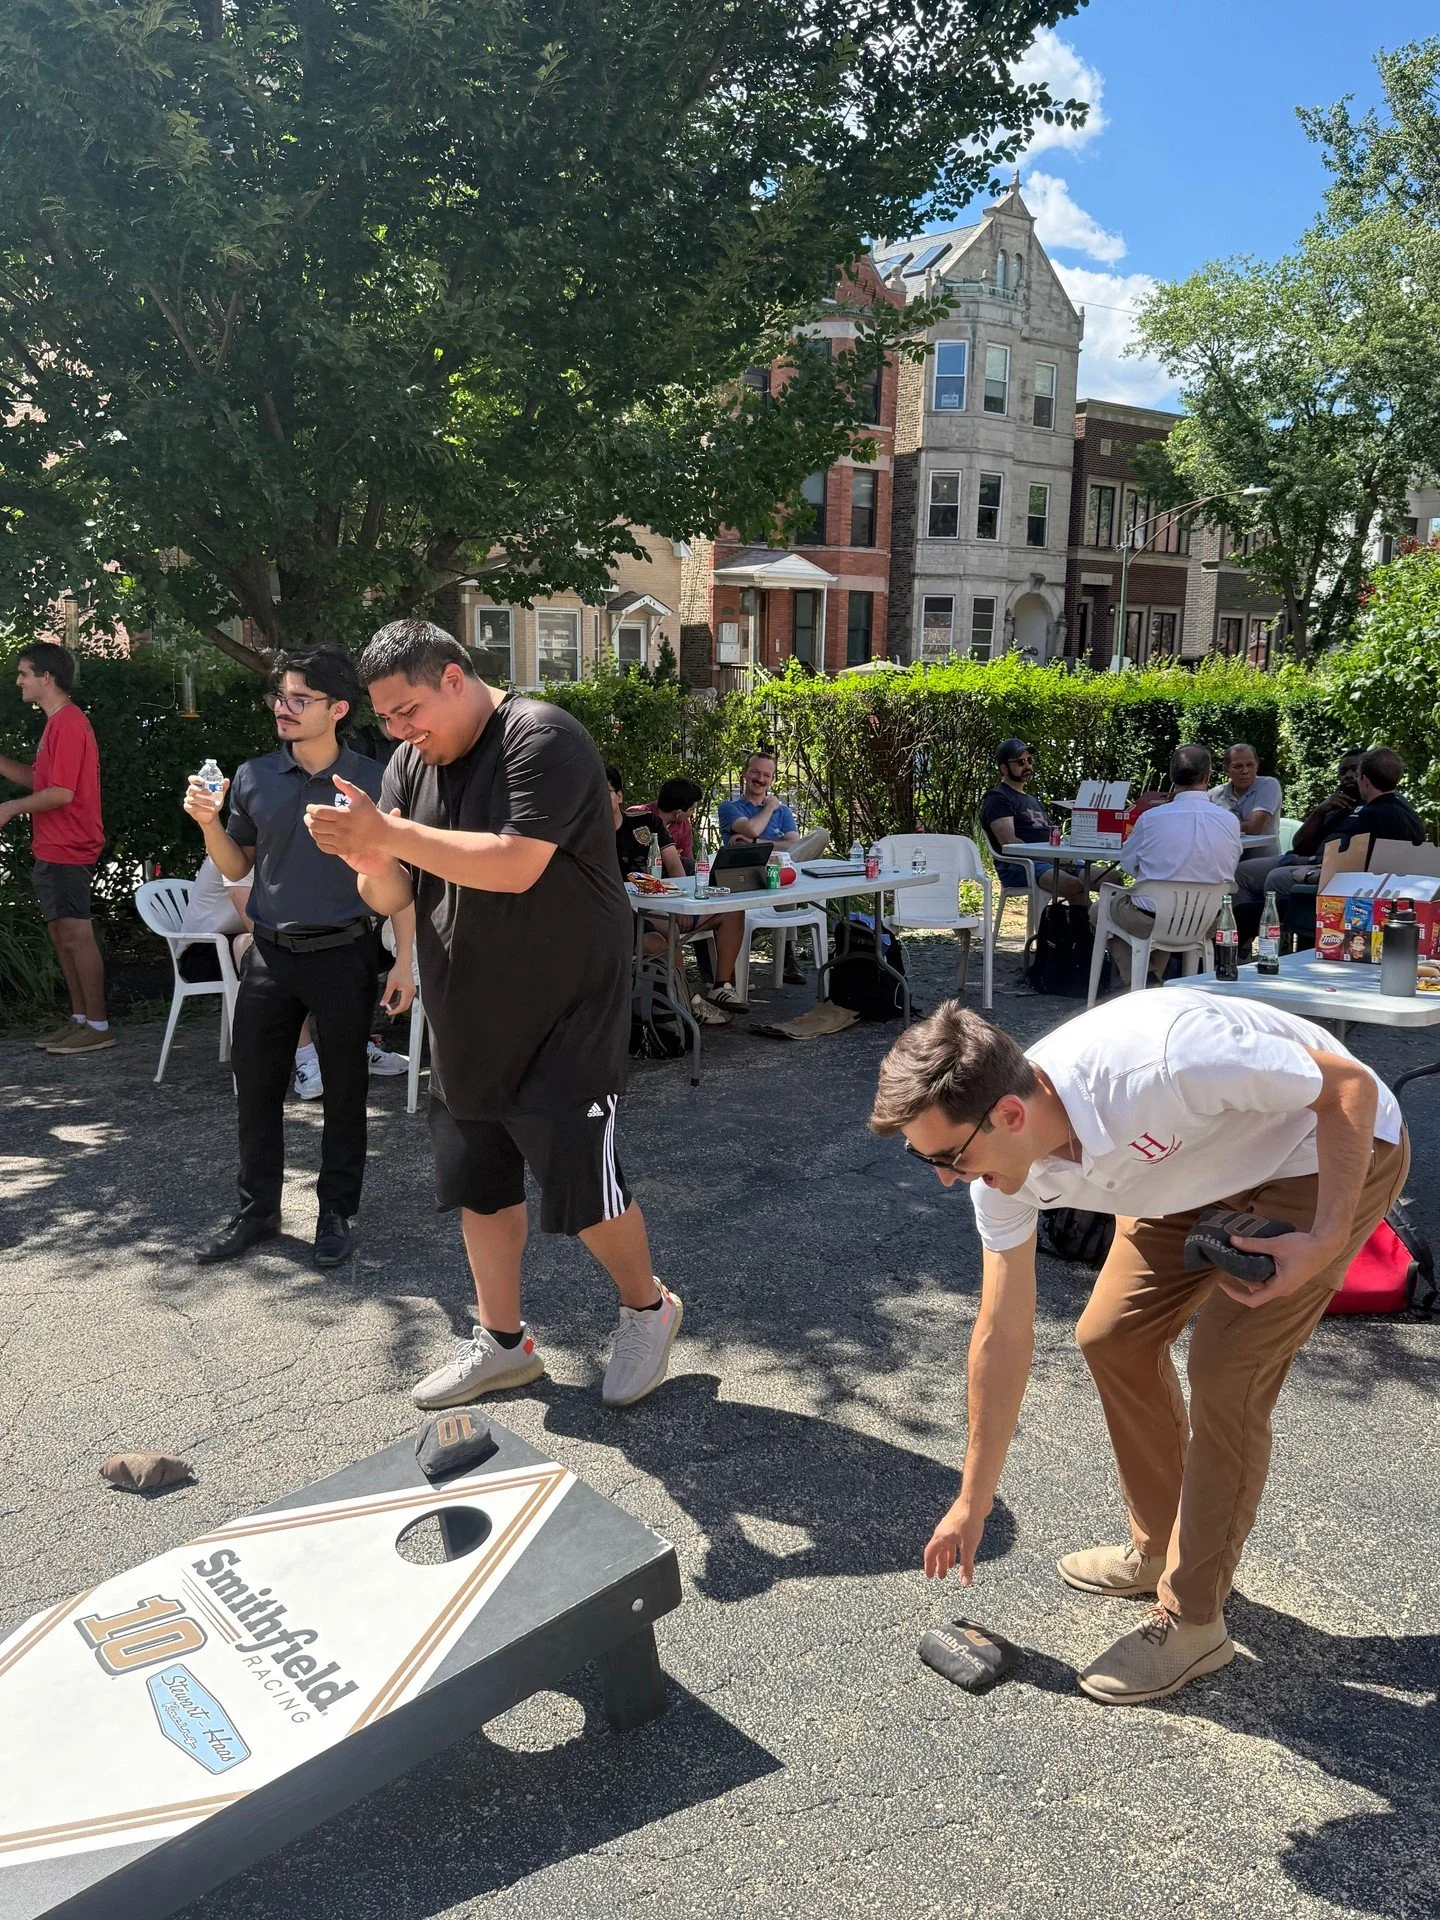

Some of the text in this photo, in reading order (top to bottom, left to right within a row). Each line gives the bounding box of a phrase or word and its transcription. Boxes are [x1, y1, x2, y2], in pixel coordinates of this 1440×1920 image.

[1199, 1209, 1270, 1238] 10
[437, 1414, 477, 1448] 10
[73, 1594, 209, 1676] 10
[191, 1548, 360, 1713] Smithfield
[931, 1629, 986, 1673] mithfield
[242, 1655, 311, 1724] RACING
[162, 1701, 197, 1750] Racing
